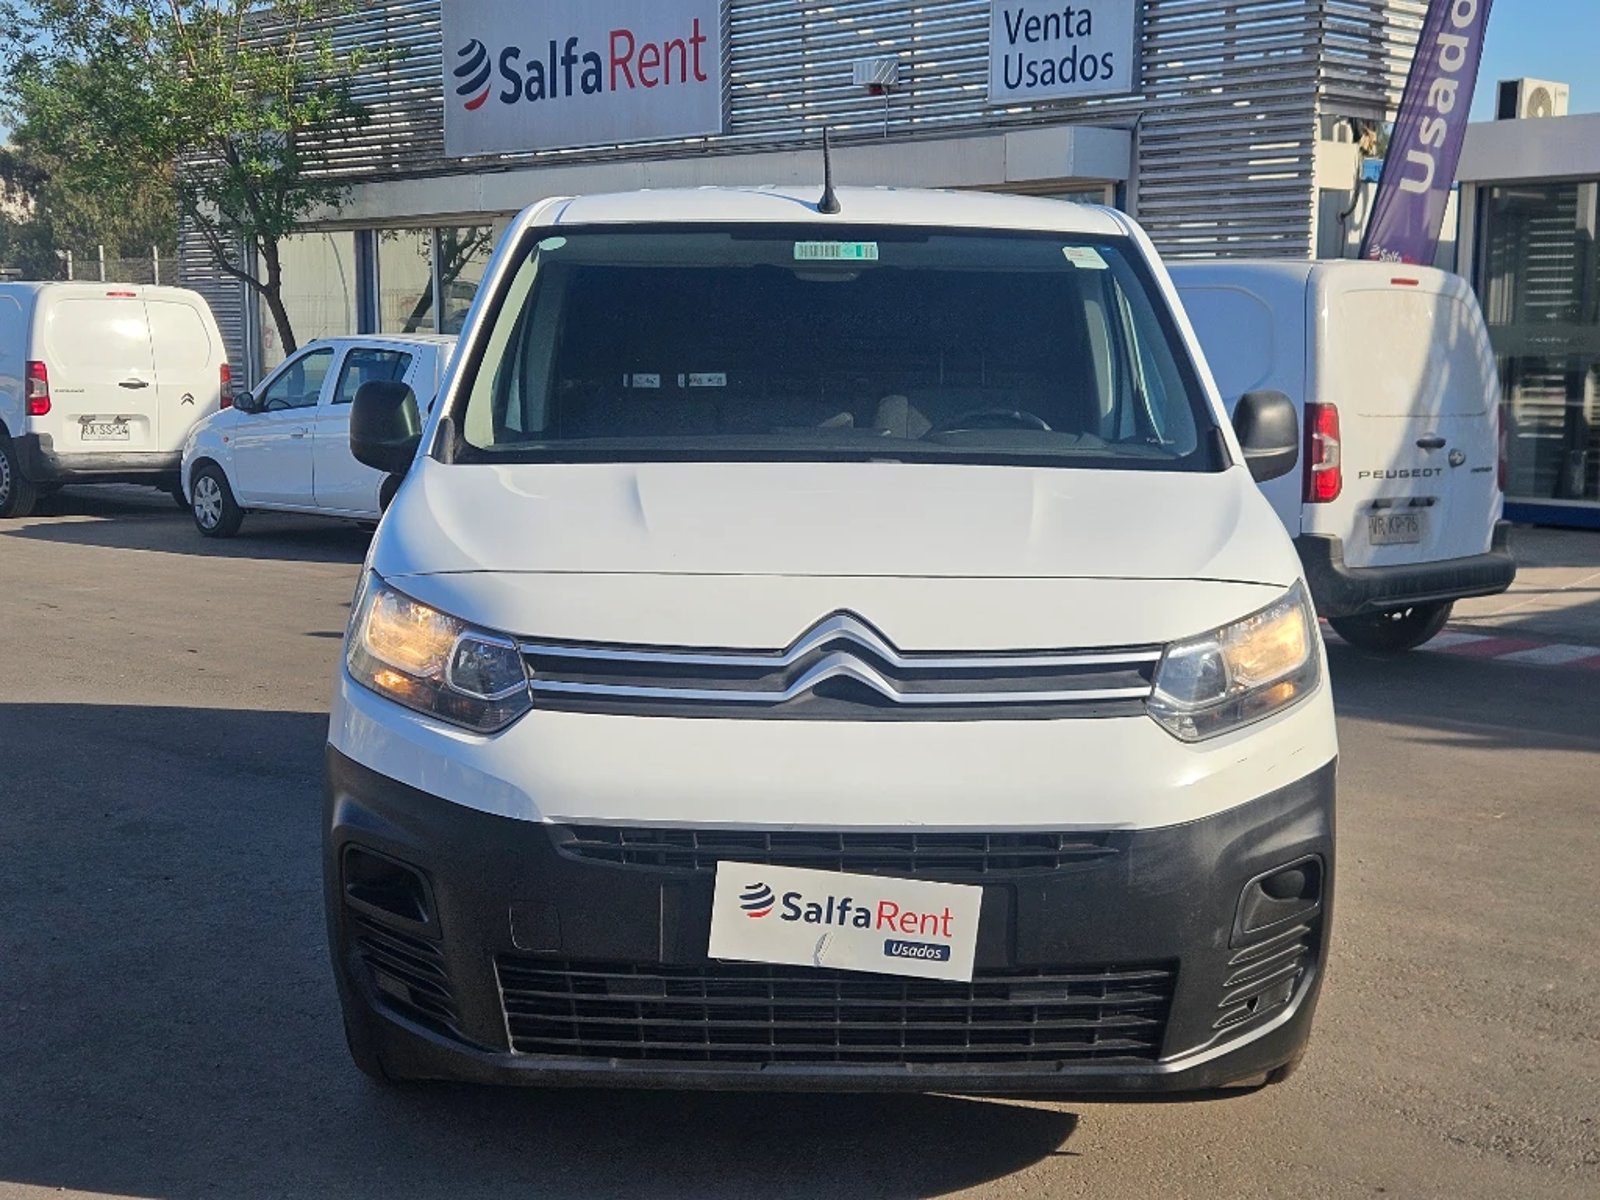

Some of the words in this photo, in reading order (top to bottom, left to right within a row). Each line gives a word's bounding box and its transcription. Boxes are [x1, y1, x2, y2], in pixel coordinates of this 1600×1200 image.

[1003, 6, 1093, 45] Venta
[1003, 44, 1114, 90] Usados
[1358, 468, 1443, 480] PEUGEOT
[891, 942, 942, 960] Usados
